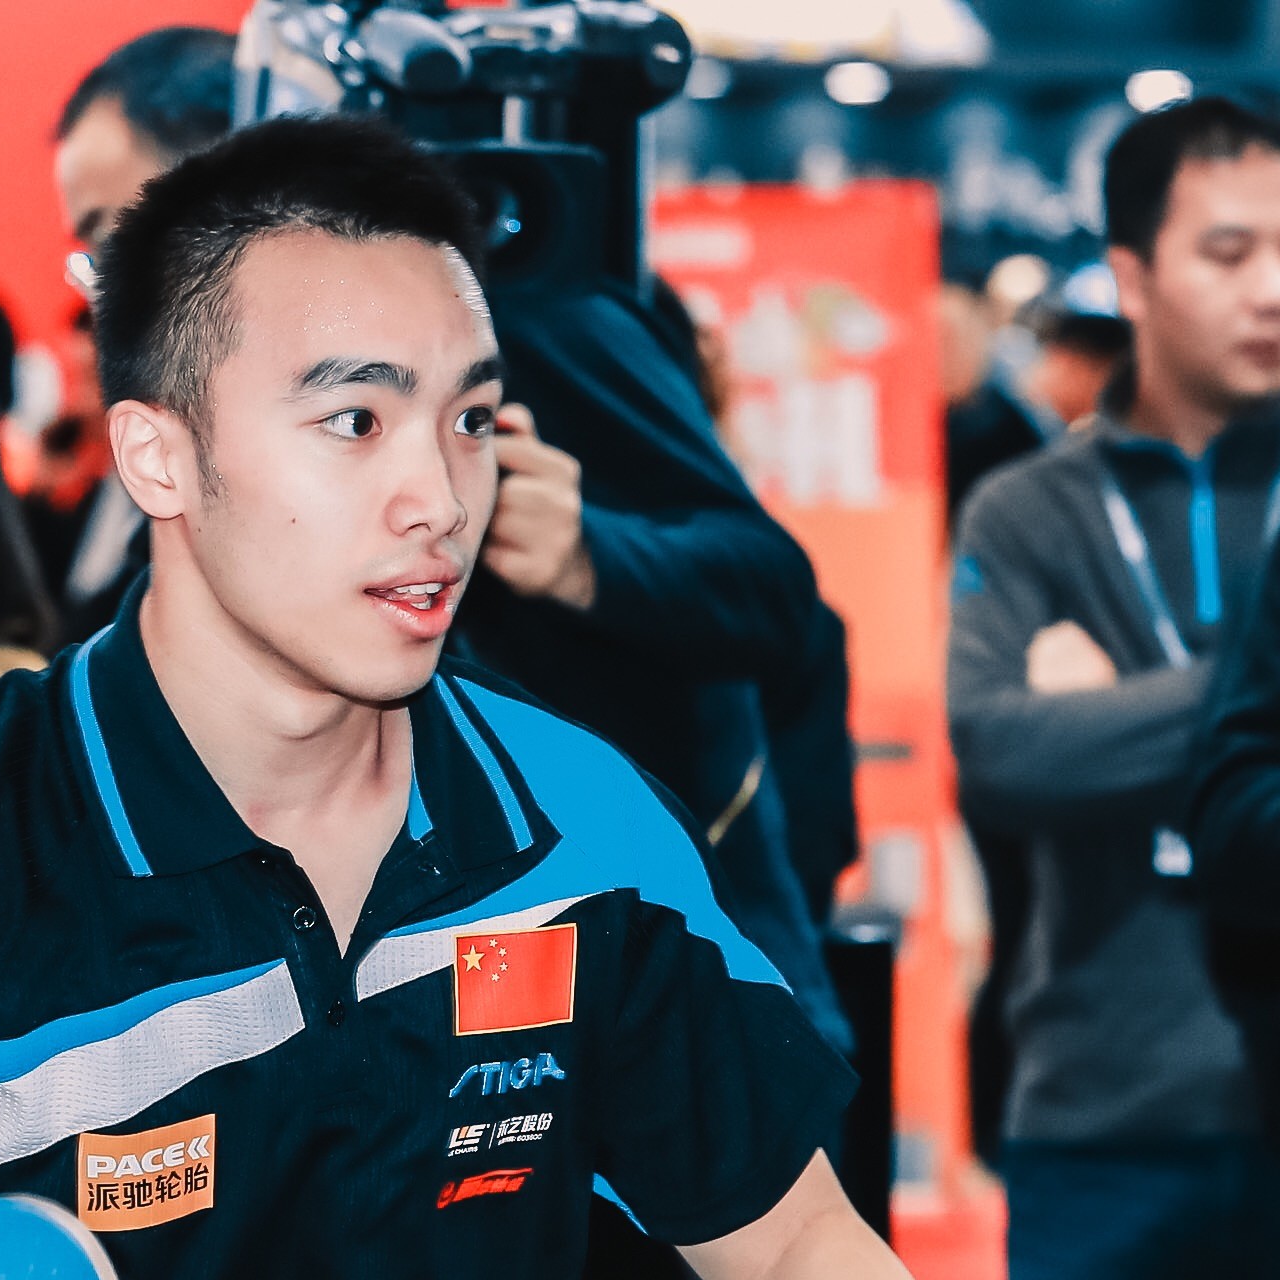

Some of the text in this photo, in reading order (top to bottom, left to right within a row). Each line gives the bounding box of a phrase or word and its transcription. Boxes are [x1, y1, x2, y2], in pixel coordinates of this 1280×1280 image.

[448, 1052, 567, 1098] STIGA
[86, 1141, 185, 1179] PACE
[87, 1162, 210, 1212] 派驰轮胎
